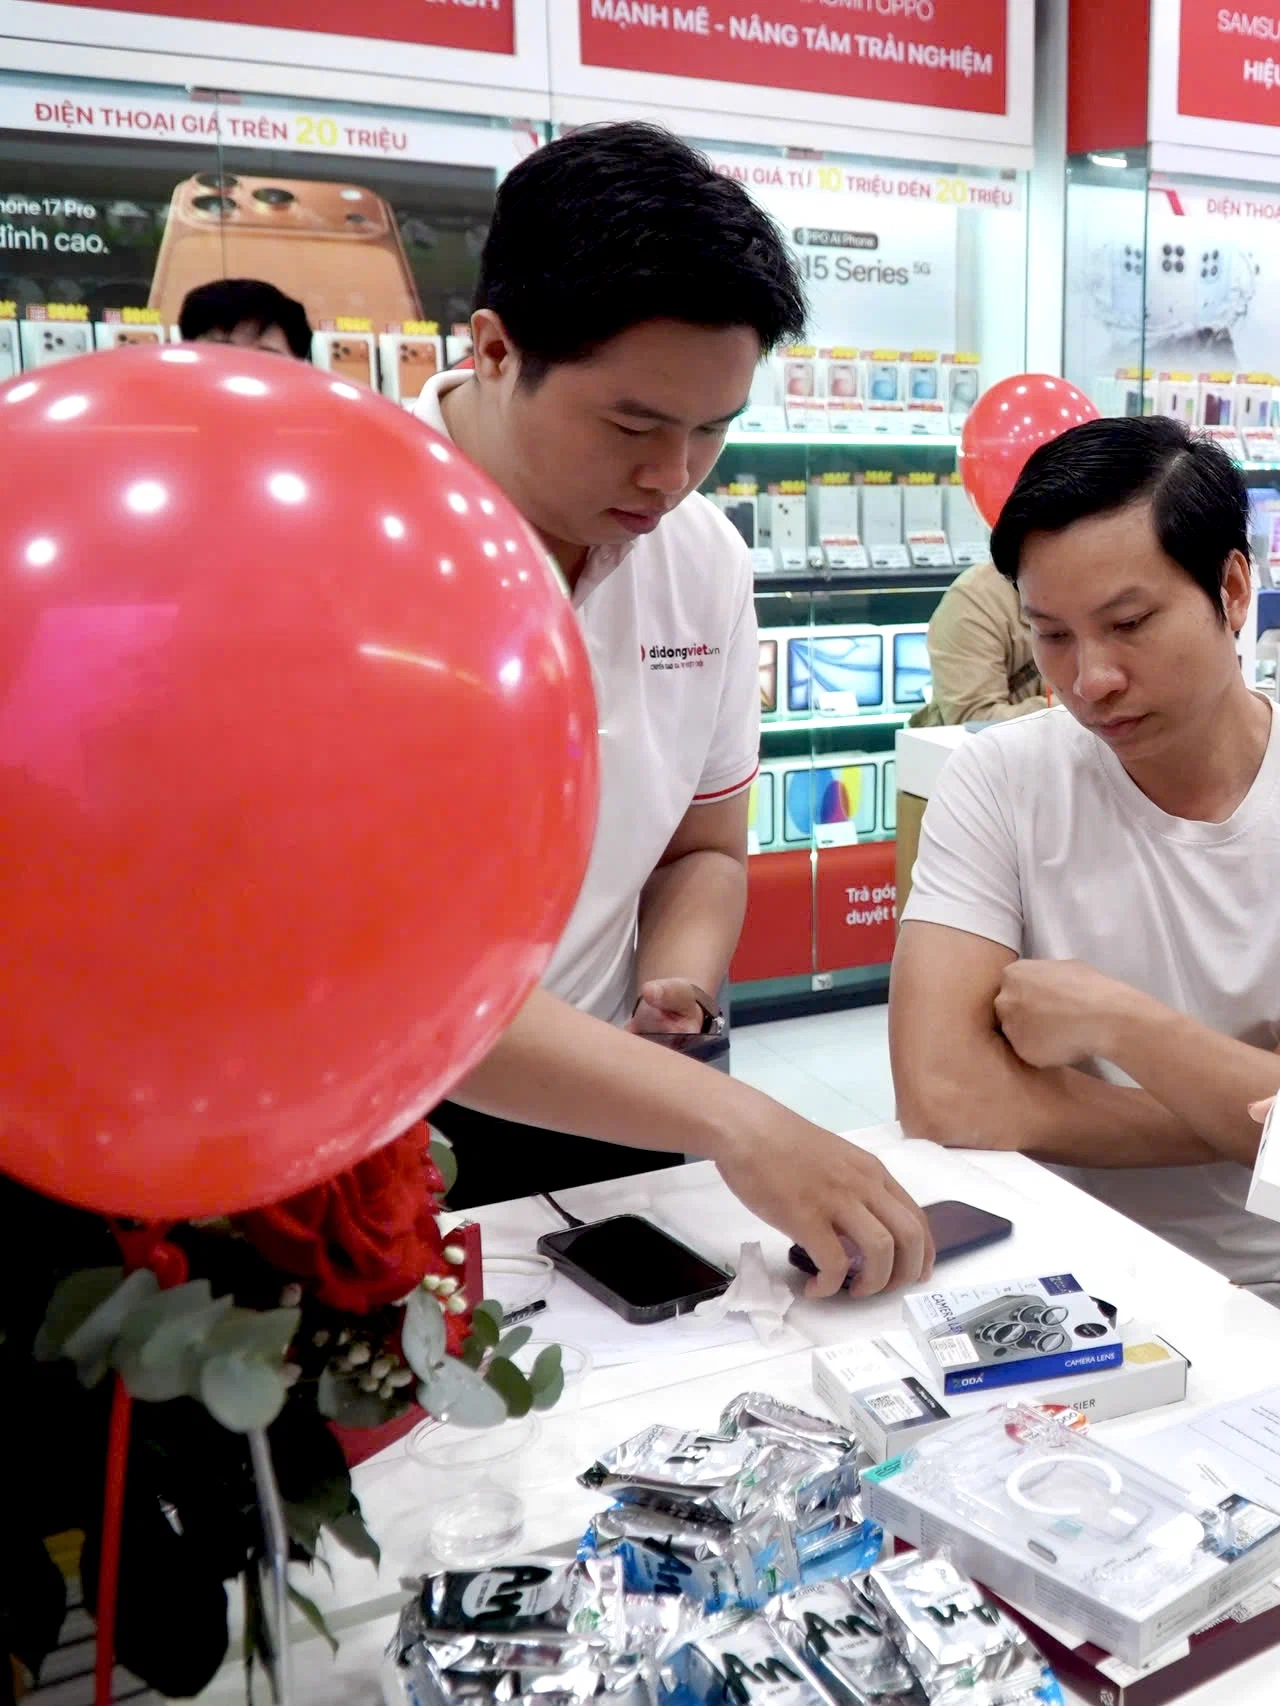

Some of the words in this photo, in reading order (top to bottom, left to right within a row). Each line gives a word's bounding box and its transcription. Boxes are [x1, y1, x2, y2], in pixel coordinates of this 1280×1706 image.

[729, 13, 799, 47] NÂNG
[907, 42, 993, 78] NGHIỆM
[35, 100, 94, 128] ĐIỆN
[100, 107, 175, 136] THOẠI
[181, 111, 222, 134] GIÁ
[228, 115, 288, 140] TRÊN
[295, 114, 339, 147] 20
[344, 126, 408, 154] TRIỆU
[817, 167, 843, 192] 10
[846, 174, 893, 197] TRIỆU
[935, 177, 967, 203] 20
[968, 185, 1013, 207] TRIỆU
[42, 198, 62, 216] 17
[64, 200, 97, 219] Pro
[54, 229, 109, 253] cao.
[834, 255, 909, 284] Series
[649, 643, 720, 660] didongviet.vn
[1064, 1356, 1096, 1368] CAMERA
[1096, 1351, 1116, 1363] LENS
[1071, 1398, 1096, 1411] SIER
[803, 1611, 882, 1657] An
[721, 1652, 804, 1706] An
